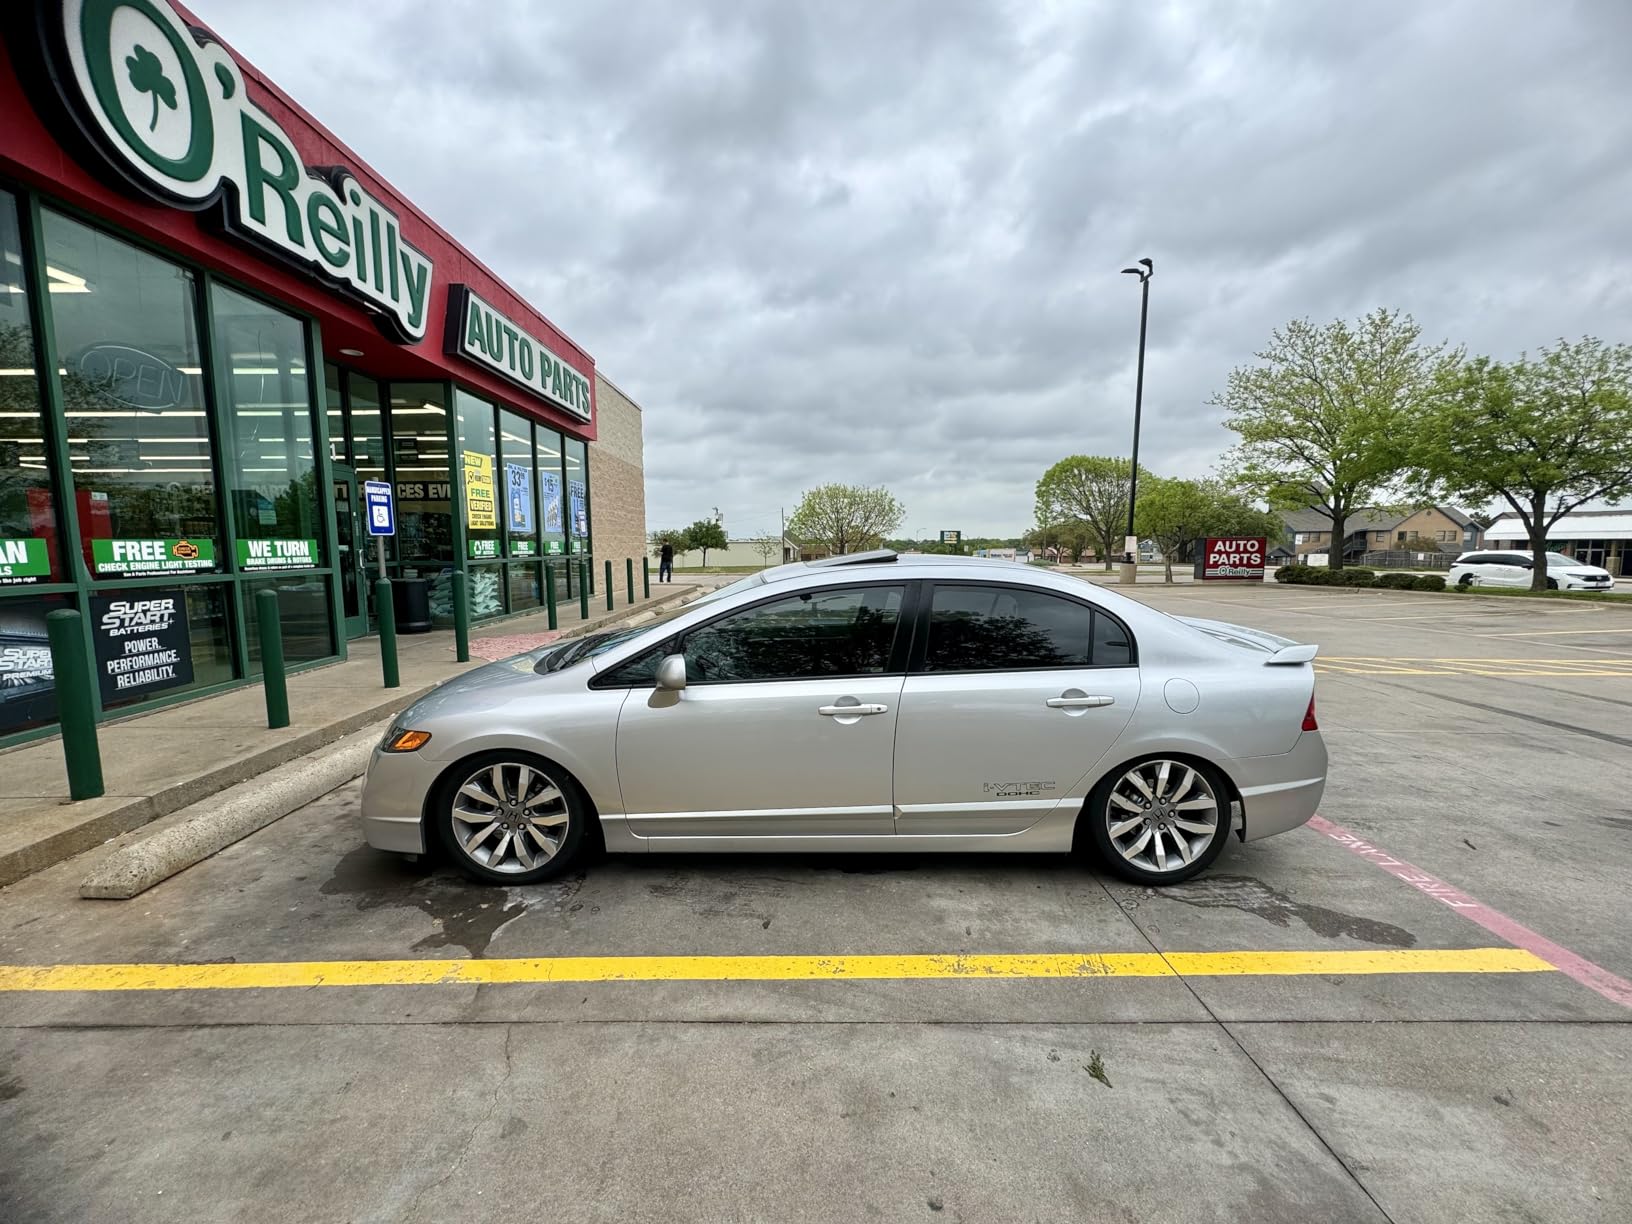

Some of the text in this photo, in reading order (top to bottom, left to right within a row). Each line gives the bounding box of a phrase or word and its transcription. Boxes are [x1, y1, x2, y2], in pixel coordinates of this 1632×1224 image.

[80, 0, 427, 330] O'Reilly
[467, 300, 591, 415] AUTO PARTS
[80, 350, 183, 404] OPEN
[470, 487, 491, 499] FREE
[112, 541, 167, 561] FREE
[248, 541, 310, 557] WE TURN
[481, 540, 495, 551] FREE
[1213, 540, 1260, 552] AUTO
[98, 559, 213, 572] CHECK ENGINE LIGHT TESTING
[246, 557, 267, 566] BRAKE
[1209, 553, 1262, 565] PARTS
[1218, 565, 1252, 576] O'Reilly
[109, 598, 175, 616] SUPER
[100, 609, 177, 630] START
[109, 622, 170, 637] BATTERIES
[123, 637, 162, 654] POWER.
[3, 648, 51, 660] SUPE
[106, 649, 181, 674] PERFORMANCE.
[116, 665, 176, 688] RELIABILITY.
[1327, 833, 1479, 908] FIRE LANE
